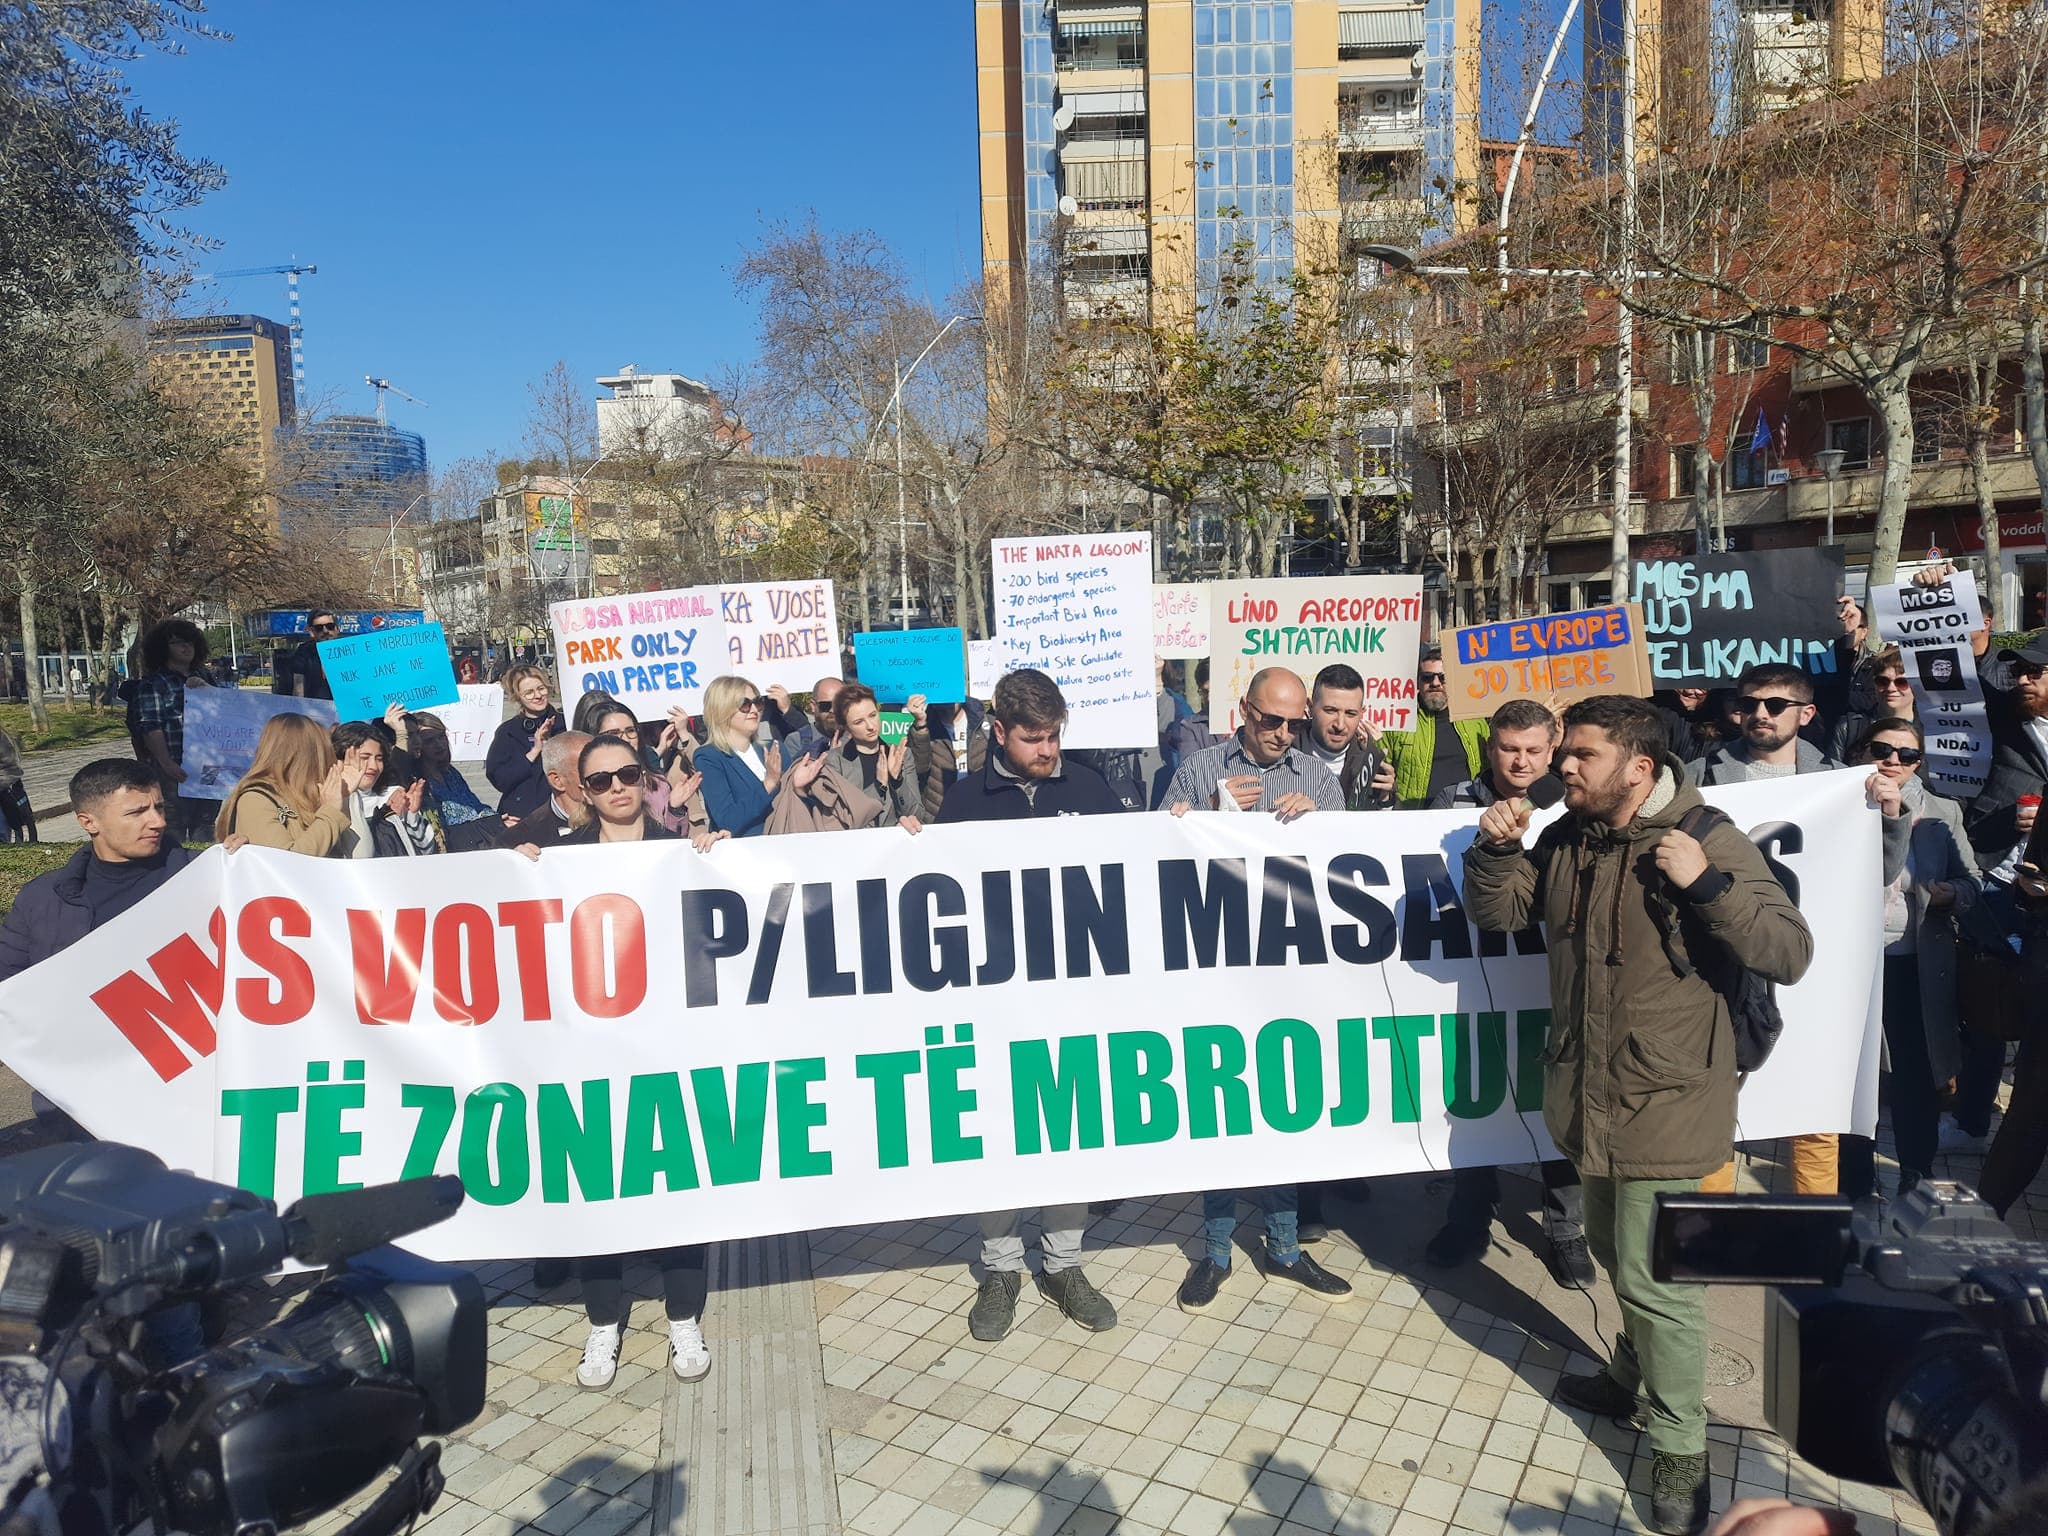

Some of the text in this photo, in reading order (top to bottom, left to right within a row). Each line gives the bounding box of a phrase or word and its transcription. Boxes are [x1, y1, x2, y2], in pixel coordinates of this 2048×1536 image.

[1000, 539, 1149, 563] THE NARTA LAGOON:
[1009, 566, 1109, 587] 200 bird species
[1630, 560, 1754, 610] MOS MA
[767, 584, 827, 624] VJOSË
[1009, 585, 1117, 608] 70 endangered species
[554, 595, 714, 635] VJOSA NATIONAL
[1007, 605, 1118, 629] Important Bird Area
[1897, 612, 1969, 634] VOTO!
[326, 629, 439, 660] ZONAT E MBROJTURA
[566, 628, 698, 665] PARK ONLY
[757, 622, 829, 661] NARTË
[1010, 638, 1031, 655] Key
[1040, 631, 1097, 650] Biodiversity
[1100, 628, 1122, 644] Area
[1902, 633, 1968, 649] NENI 14
[1009, 658, 1050, 672] Emerald
[1055, 655, 1076, 668] Site
[1081, 650, 1123, 667] Candidate
[340, 671, 361, 684] NUK
[582, 660, 700, 695] ON PAPER
[1056, 668, 1133, 687] Natura 2000 site
[1366, 676, 1415, 701] PARA
[1467, 665, 1508, 699] JO
[1940, 702, 1962, 713] JU
[200, 724, 231, 738] WHO
[1937, 719, 1974, 729] DUA
[1936, 738, 1981, 751] NDAJ
[1950, 757, 1970, 768] JU
[90, 896, 315, 1083] MS
[346, 892, 648, 1026] VOTO
[681, 861, 1131, 1008] P/LIGJIN
[221, 1060, 366, 1200] TË
[400, 1056, 833, 1207] ZONAVE
[856, 1022, 983, 1170] TË
